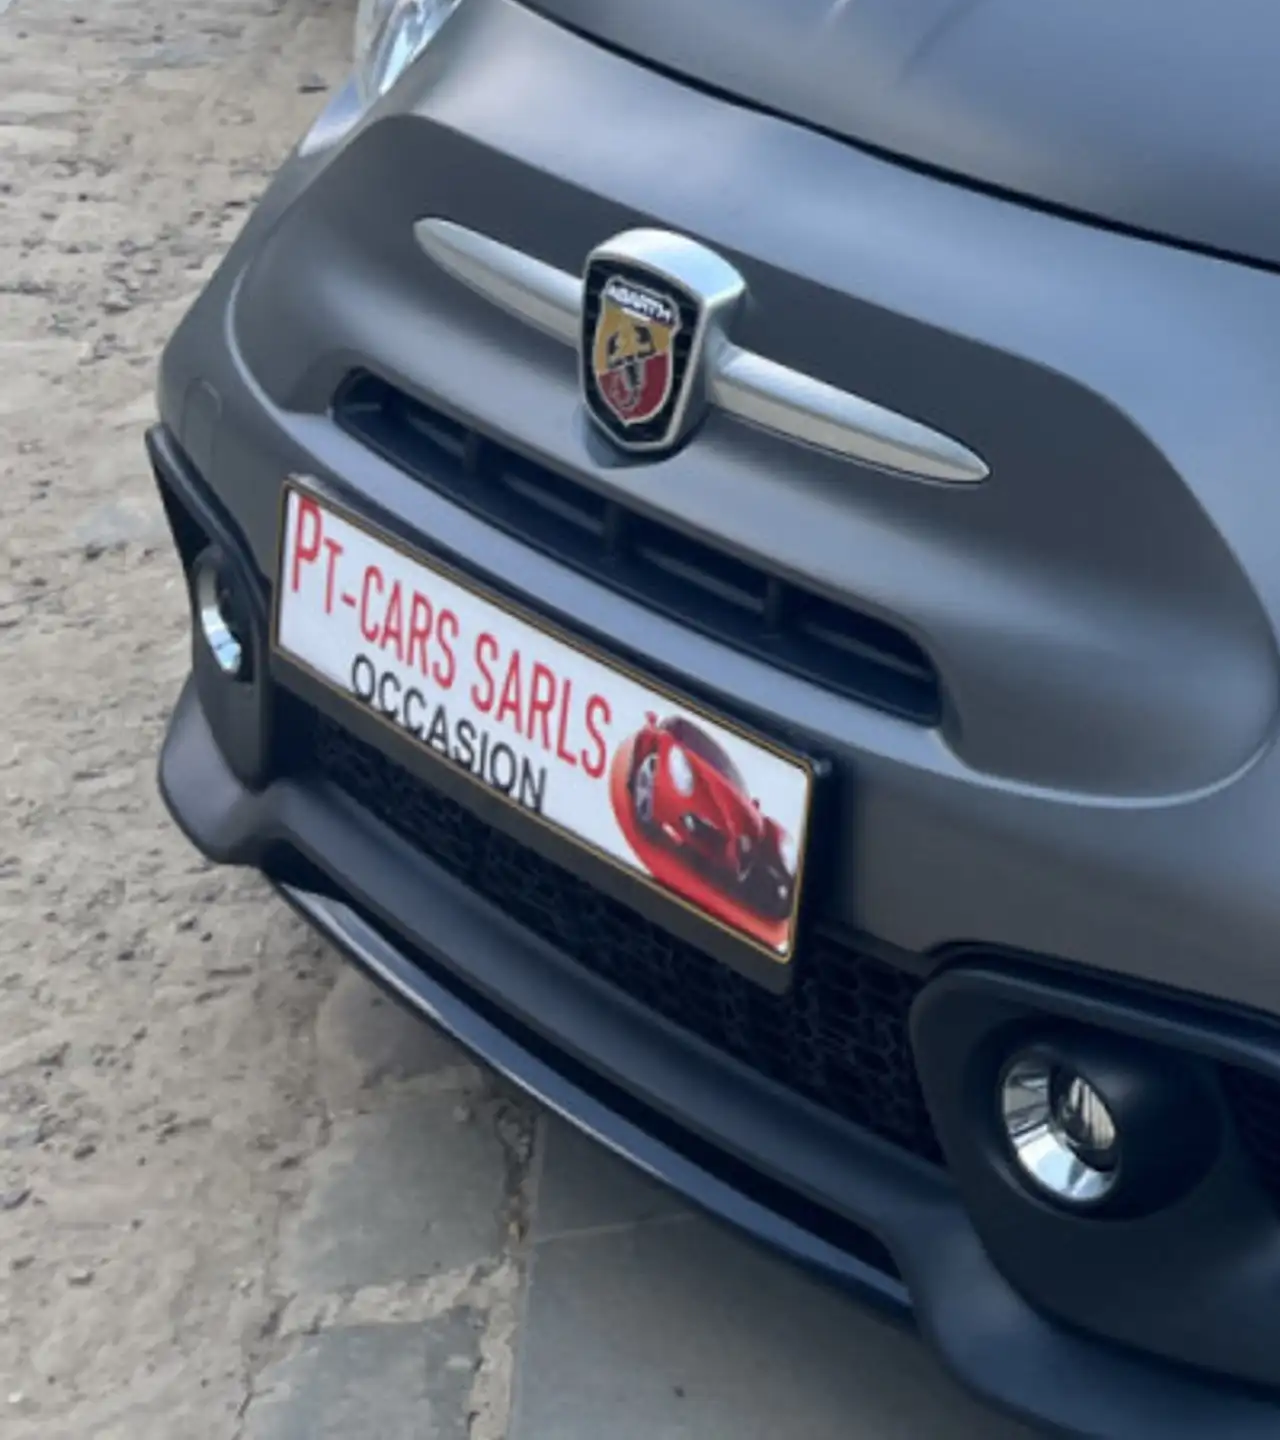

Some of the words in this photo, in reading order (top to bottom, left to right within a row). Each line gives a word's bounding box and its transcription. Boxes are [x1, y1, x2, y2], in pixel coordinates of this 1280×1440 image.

[290, 496, 459, 690] PT-CARS
[471, 631, 613, 780] SARLS
[350, 653, 548, 814] OCCASION
